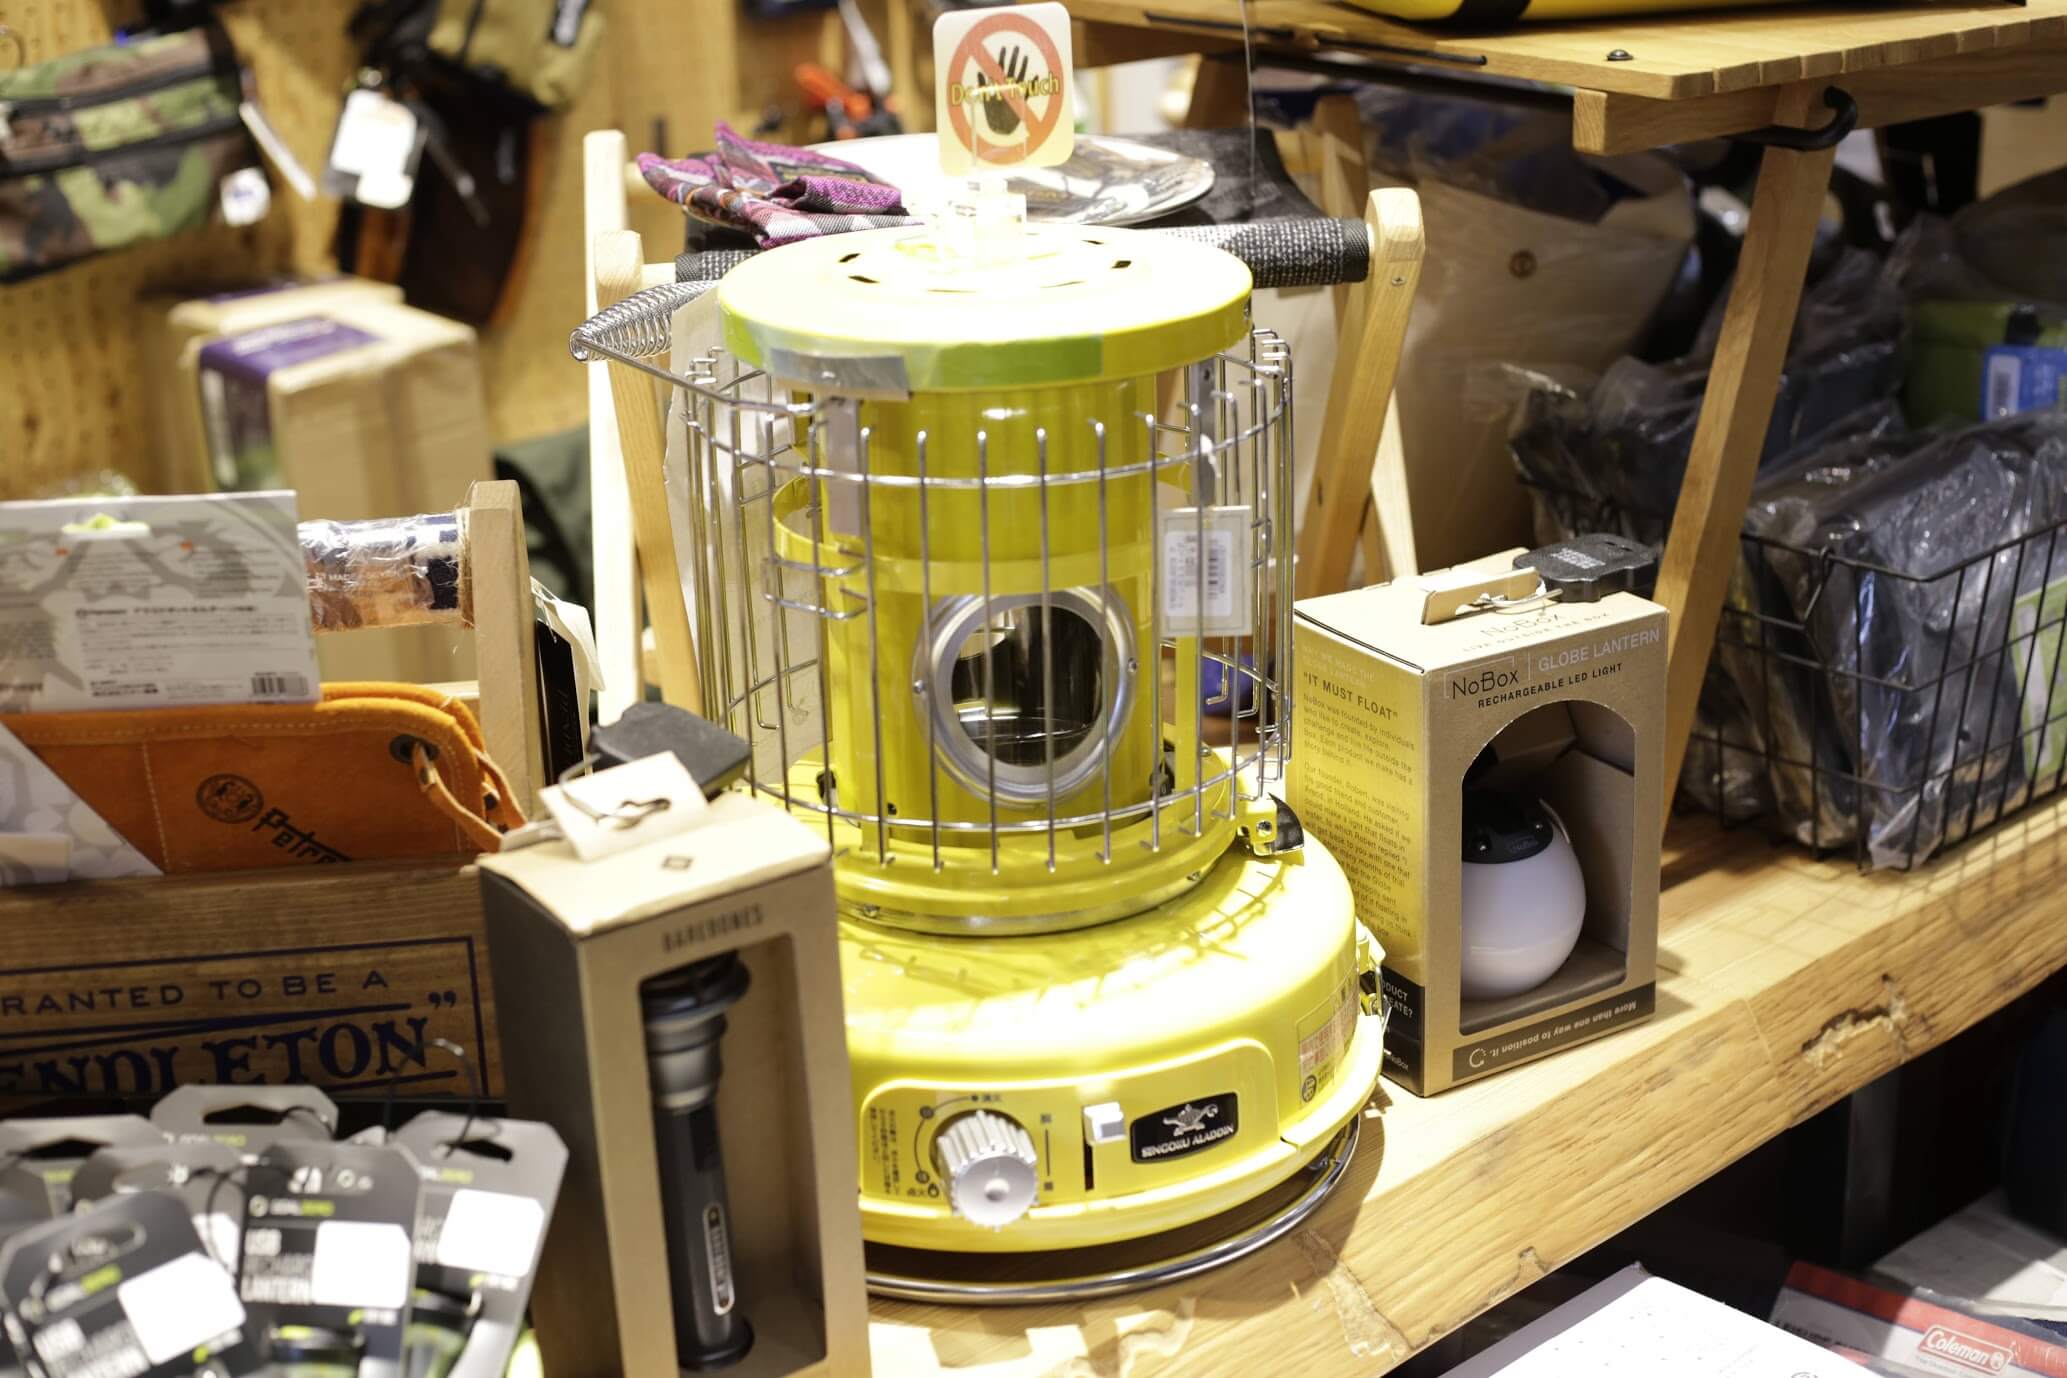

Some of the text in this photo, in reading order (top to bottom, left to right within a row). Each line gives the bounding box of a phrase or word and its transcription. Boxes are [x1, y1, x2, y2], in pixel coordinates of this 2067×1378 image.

[952, 72, 1059, 105] Don't Touch
[1452, 628, 1660, 699] NoBox GLOBE LANTERN
[1323, 680, 1353, 702] MUST
[1478, 663, 1623, 708] RECHARGEABLE LED LIGHT
[209, 978, 262, 1000] TO
[282, 973, 337, 996] BE
[361, 970, 389, 990] A
[1489, 1000, 1637, 1057] More than one way to position it.
[1192, 1123, 1234, 1145] ALADDIN
[1927, 1330, 1990, 1366] Coleman
